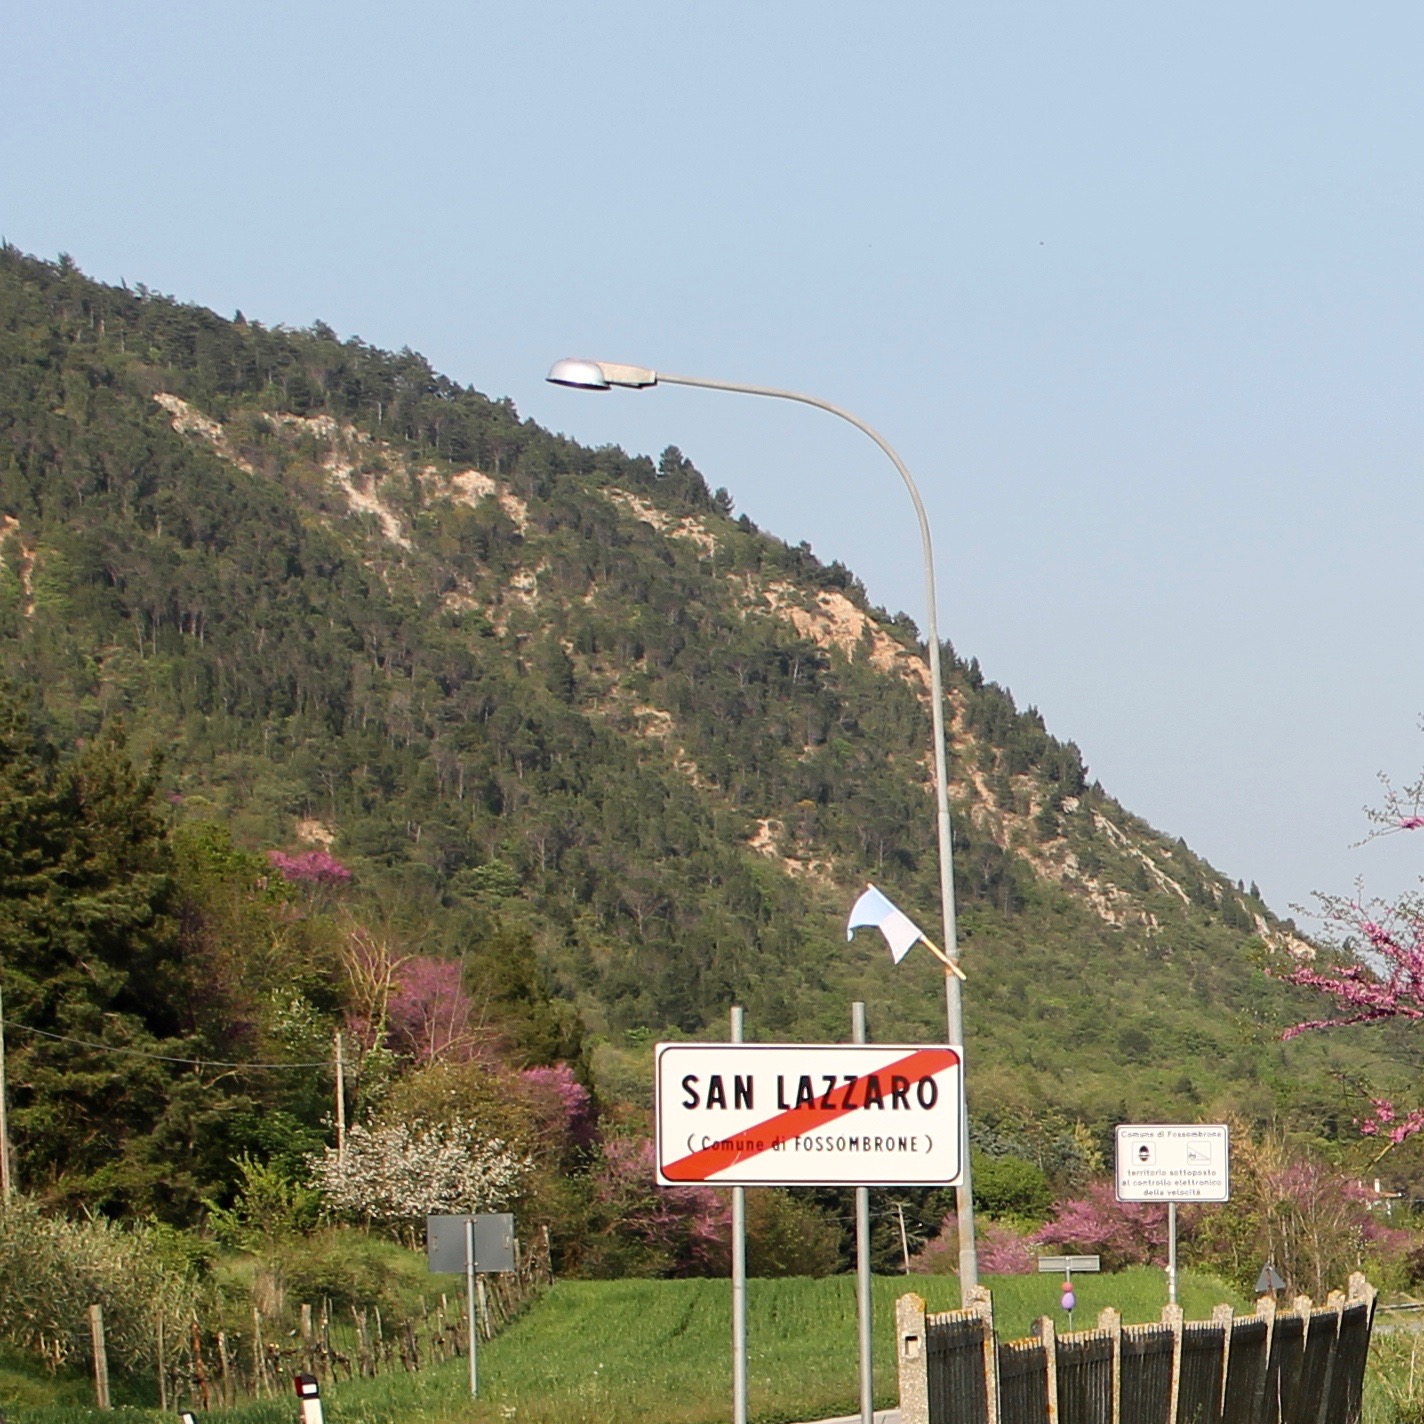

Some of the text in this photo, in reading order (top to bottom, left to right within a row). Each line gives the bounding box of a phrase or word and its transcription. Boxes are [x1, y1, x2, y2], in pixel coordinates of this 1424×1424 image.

[681, 1074, 939, 1110] SAN LAZZARO
[772, 1135, 786, 1152] di
[1169, 1169, 1216, 1177] sottoposto
